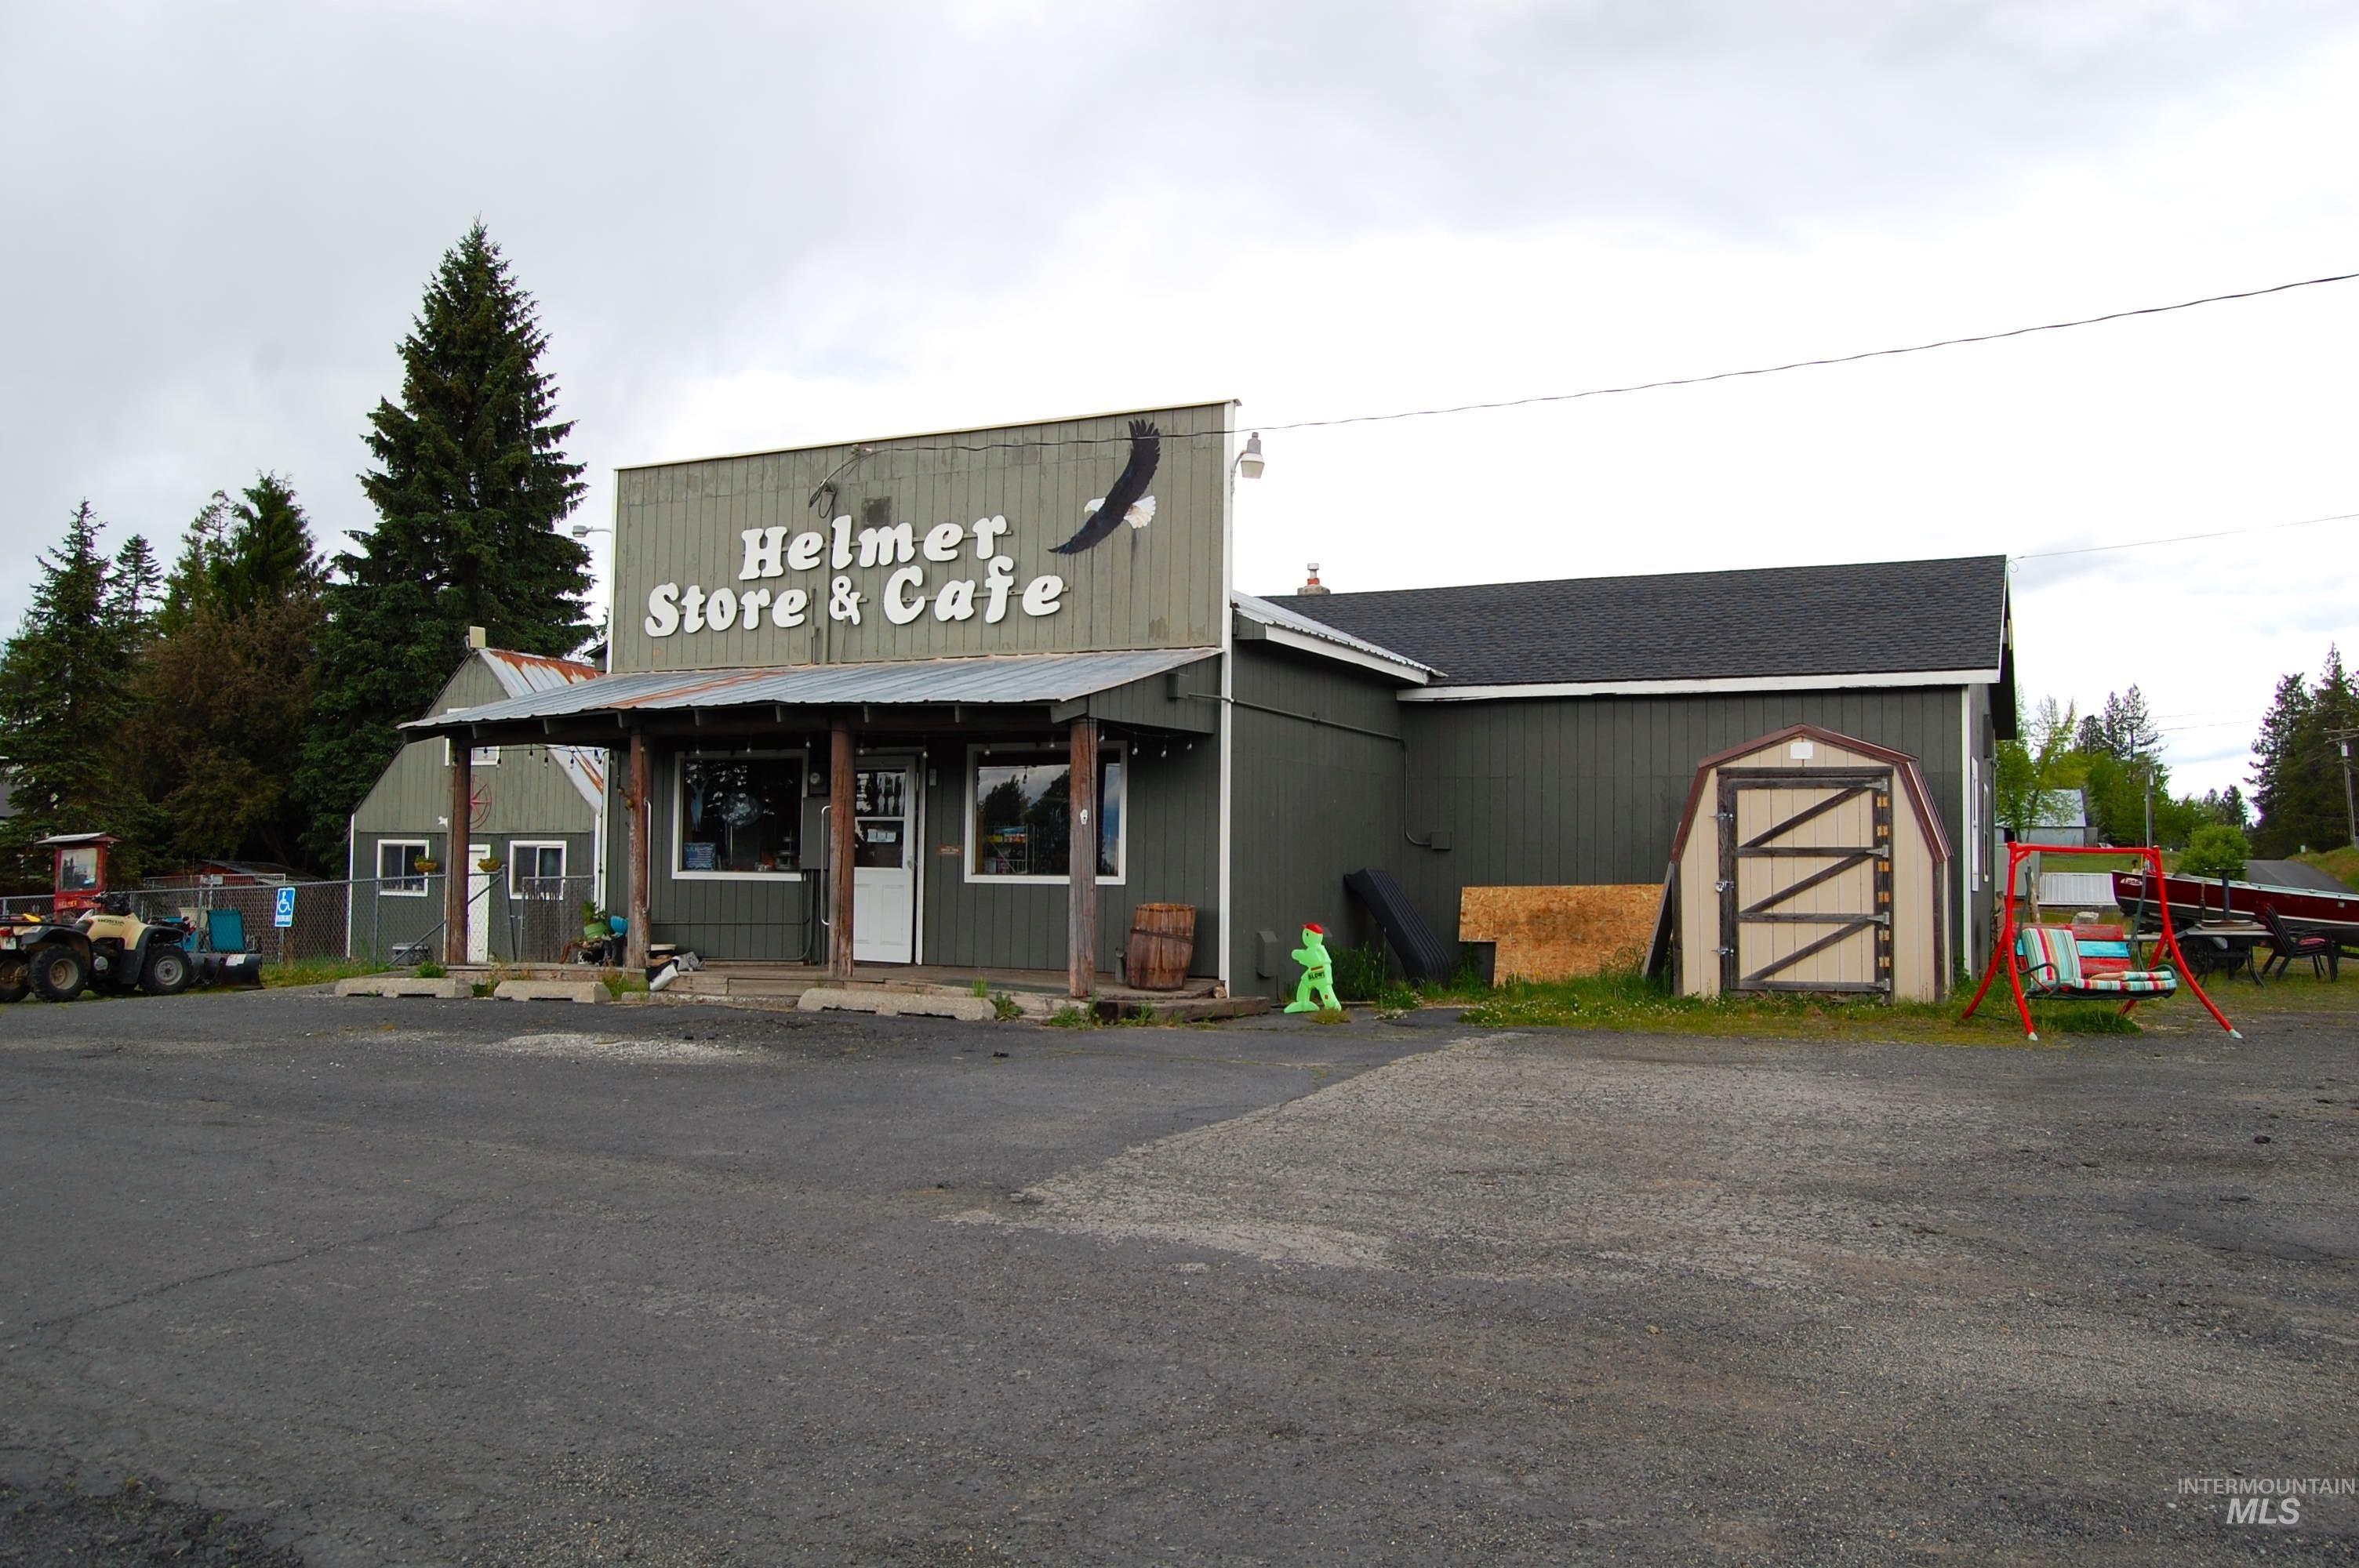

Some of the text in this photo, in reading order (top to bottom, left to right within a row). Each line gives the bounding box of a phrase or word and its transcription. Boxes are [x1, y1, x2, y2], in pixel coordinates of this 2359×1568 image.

[738, 514, 1008, 580] Helmer
[645, 555, 1064, 637] Store & Cafe
